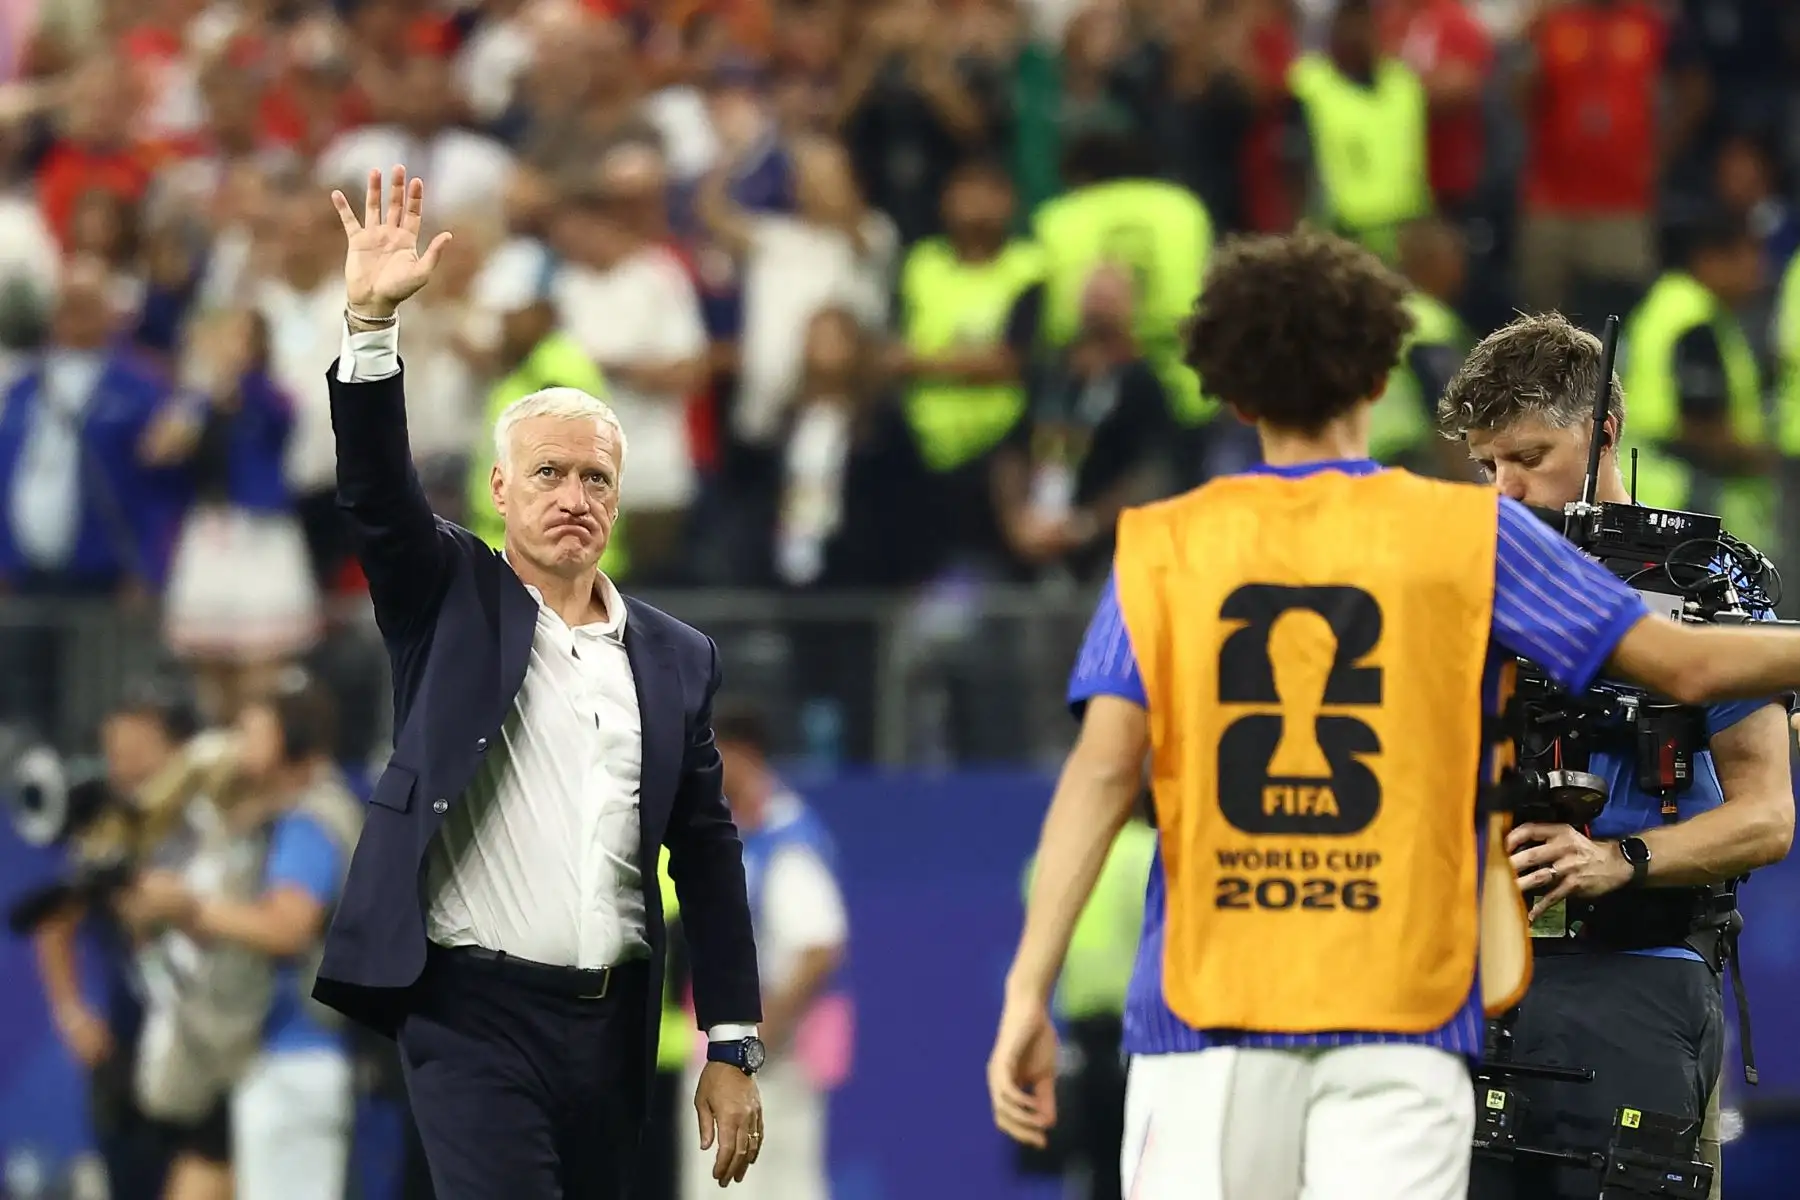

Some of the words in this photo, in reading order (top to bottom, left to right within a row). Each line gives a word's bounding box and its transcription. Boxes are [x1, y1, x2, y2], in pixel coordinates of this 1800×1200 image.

[1263, 787, 1339, 816] FIFA
[1216, 849, 1319, 870] WORLD
[1326, 849, 1382, 870] CUP
[1215, 877, 1381, 912] 2026
